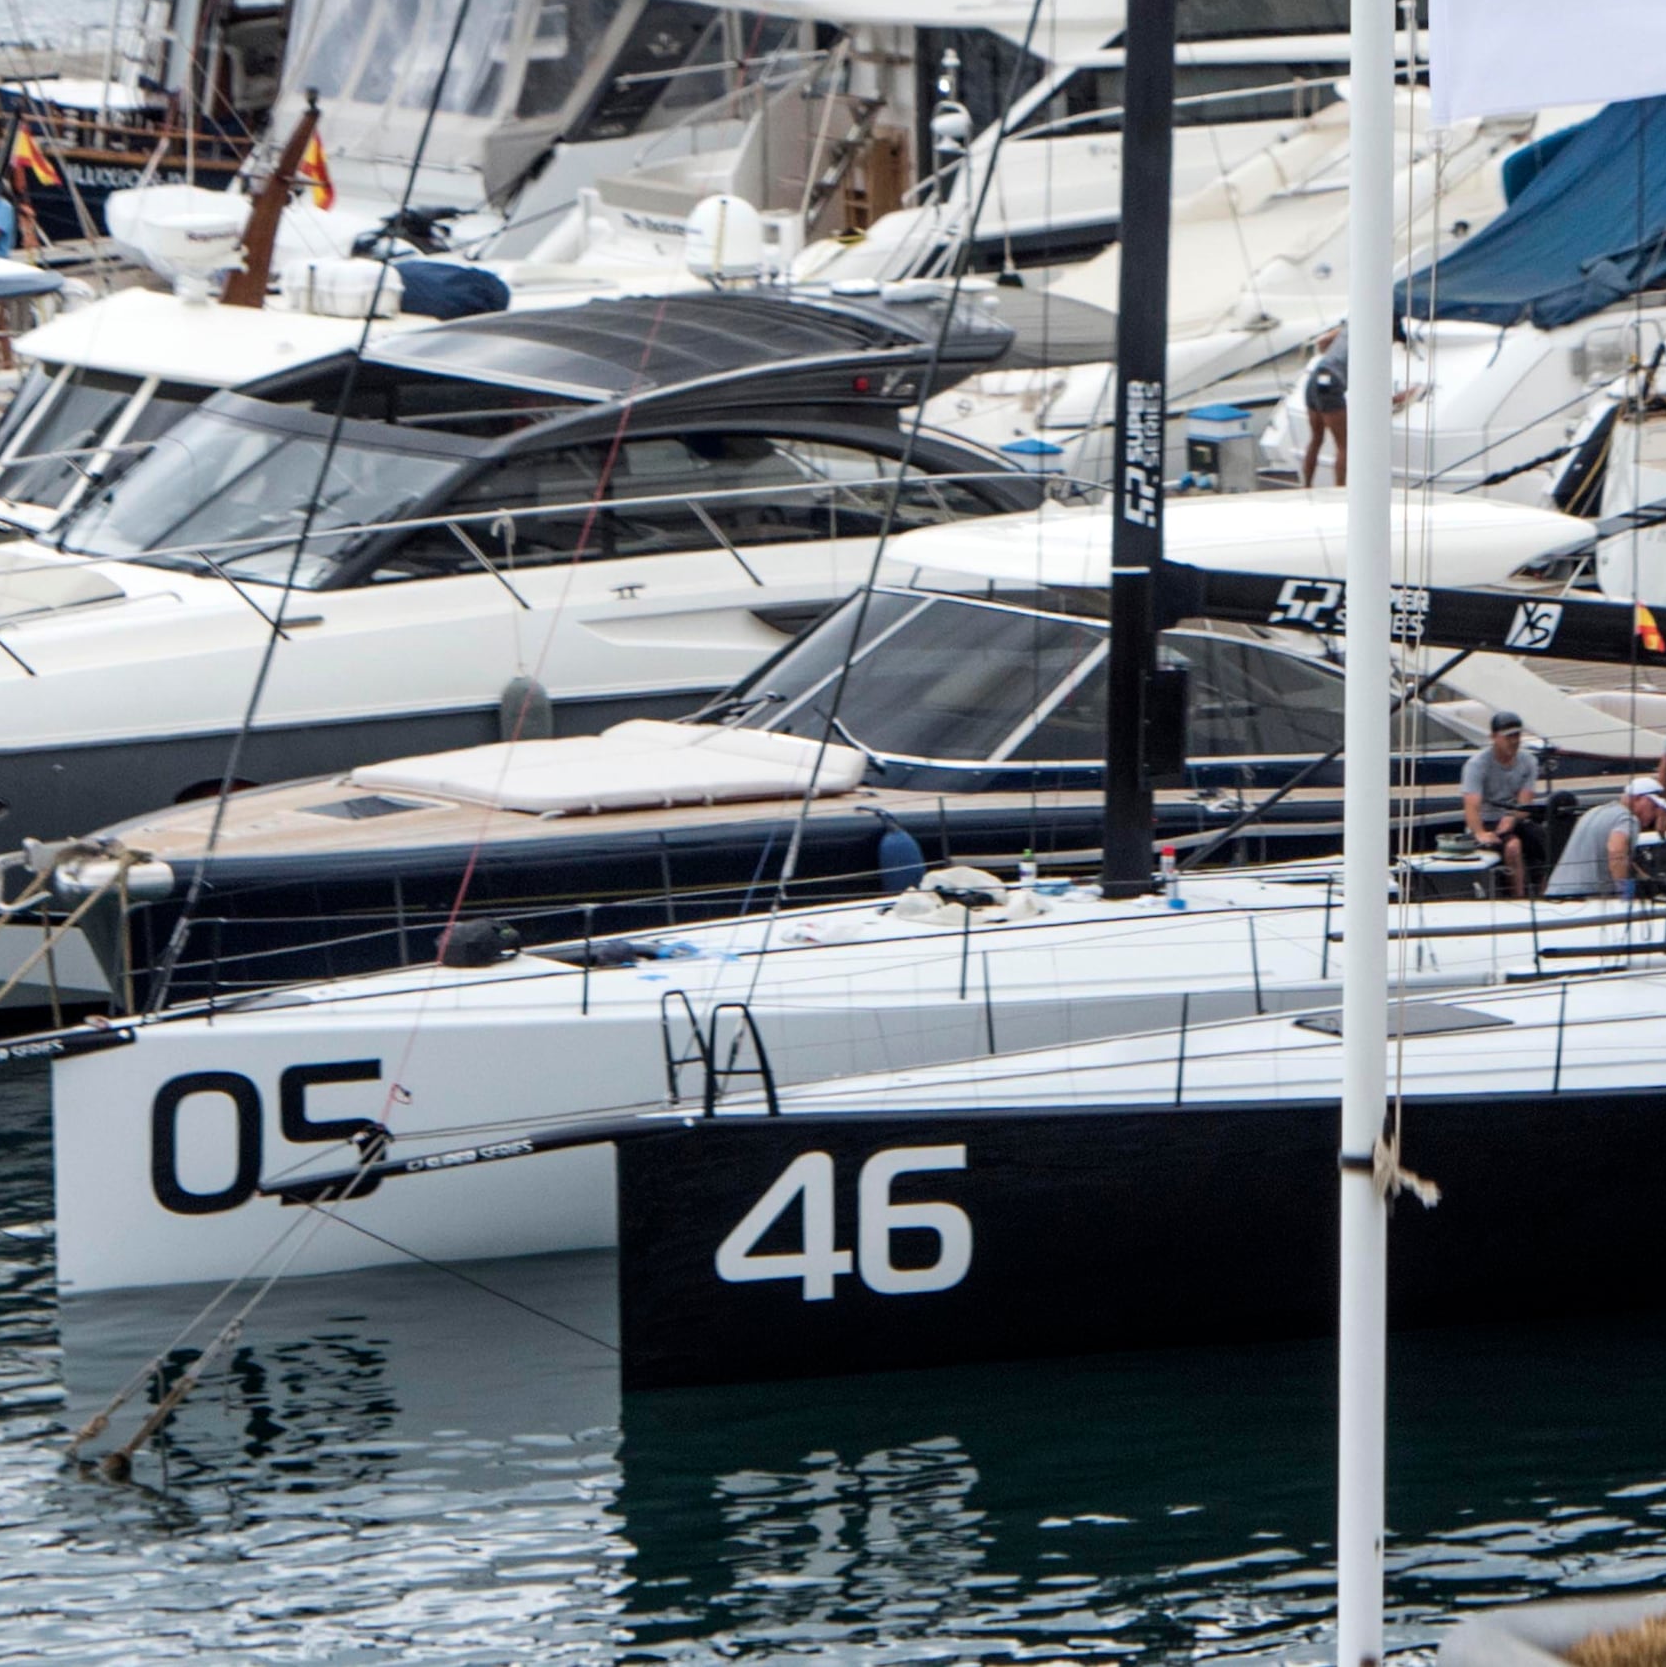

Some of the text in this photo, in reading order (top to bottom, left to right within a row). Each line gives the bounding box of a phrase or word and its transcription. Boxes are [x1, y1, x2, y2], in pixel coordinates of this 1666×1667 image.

[1123, 380, 1159, 529] 52 SUPER
[1142, 380, 1162, 469] SERIES
[1268, 579, 1343, 629] 52
[715, 1142, 973, 1303] 46
